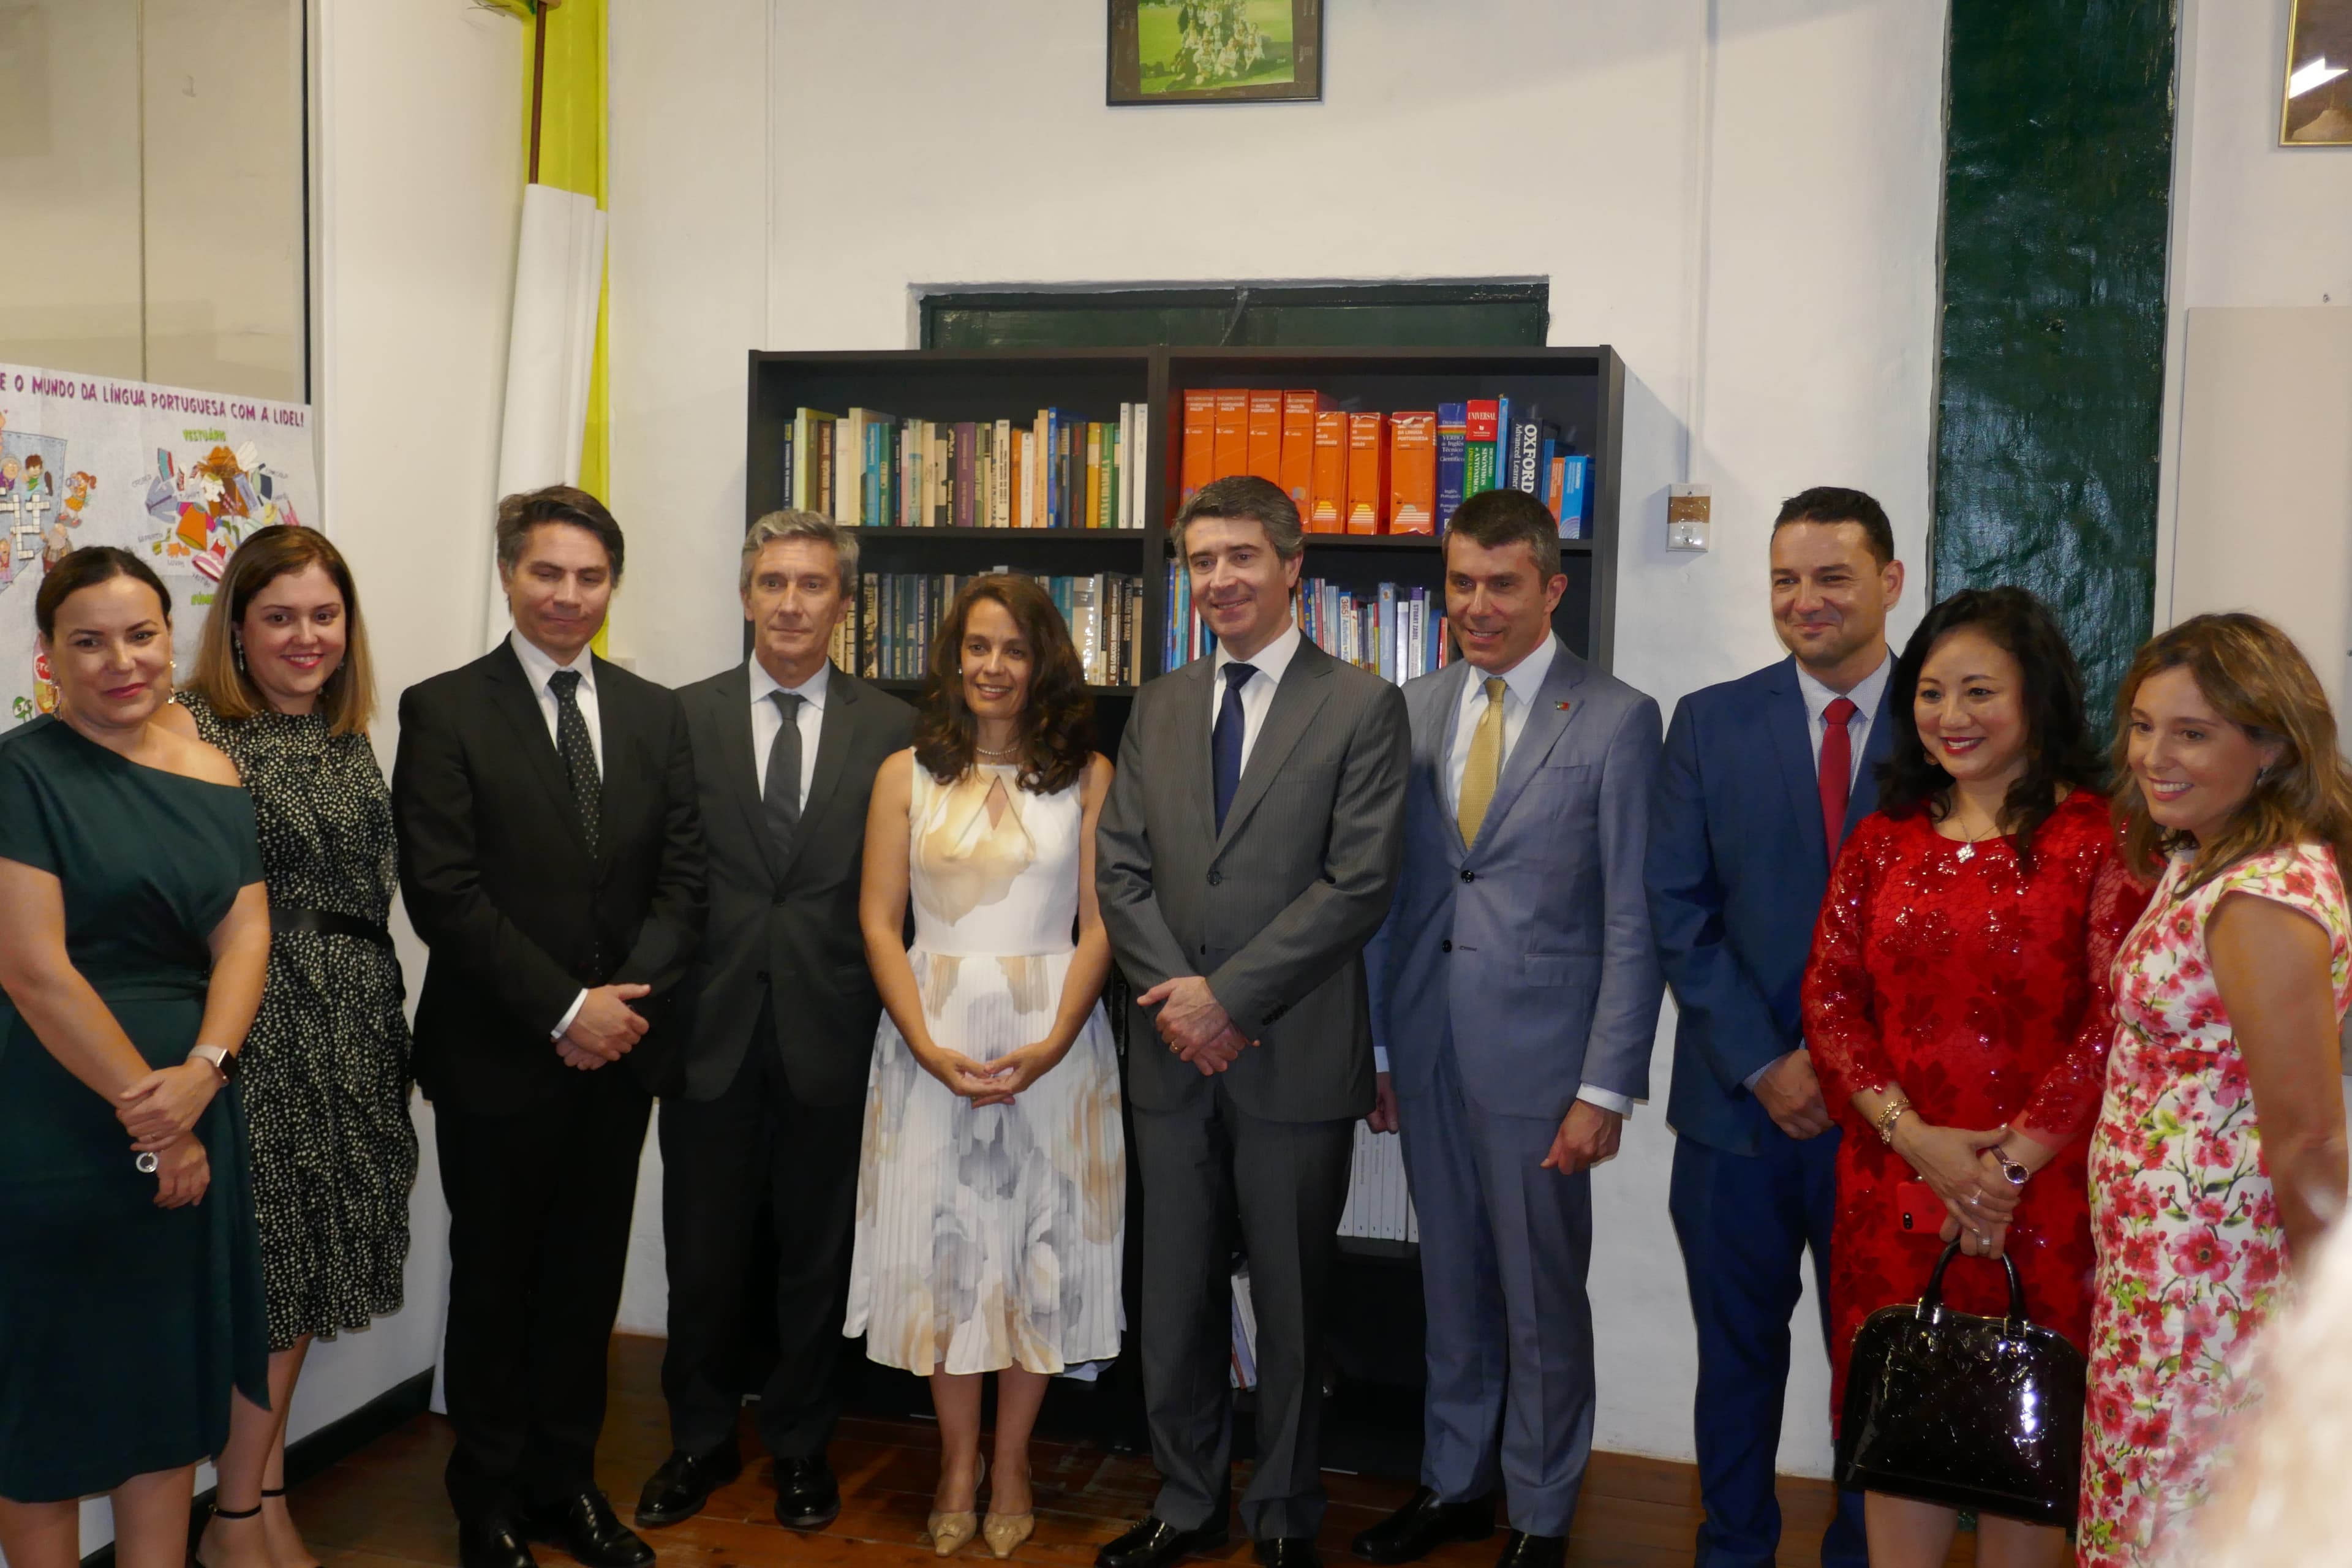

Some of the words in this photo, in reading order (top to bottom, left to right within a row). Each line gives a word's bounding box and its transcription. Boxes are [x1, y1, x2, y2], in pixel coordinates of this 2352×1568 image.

[14, 374, 24, 393] O
[32, 376, 75, 399] MUNDO
[81, 382, 97, 402] DA
[103, 383, 147, 407] LÍNGUA
[151, 392, 226, 418] PORTUGUESA
[230, 402, 256, 421] COM
[261, 406, 270, 423] A
[273, 409, 305, 428] LIDEL!
[1468, 411, 1497, 421] UNIVERSAL
[1513, 423, 1523, 459] Advanced
[1521, 424, 1537, 494] OXFORD
